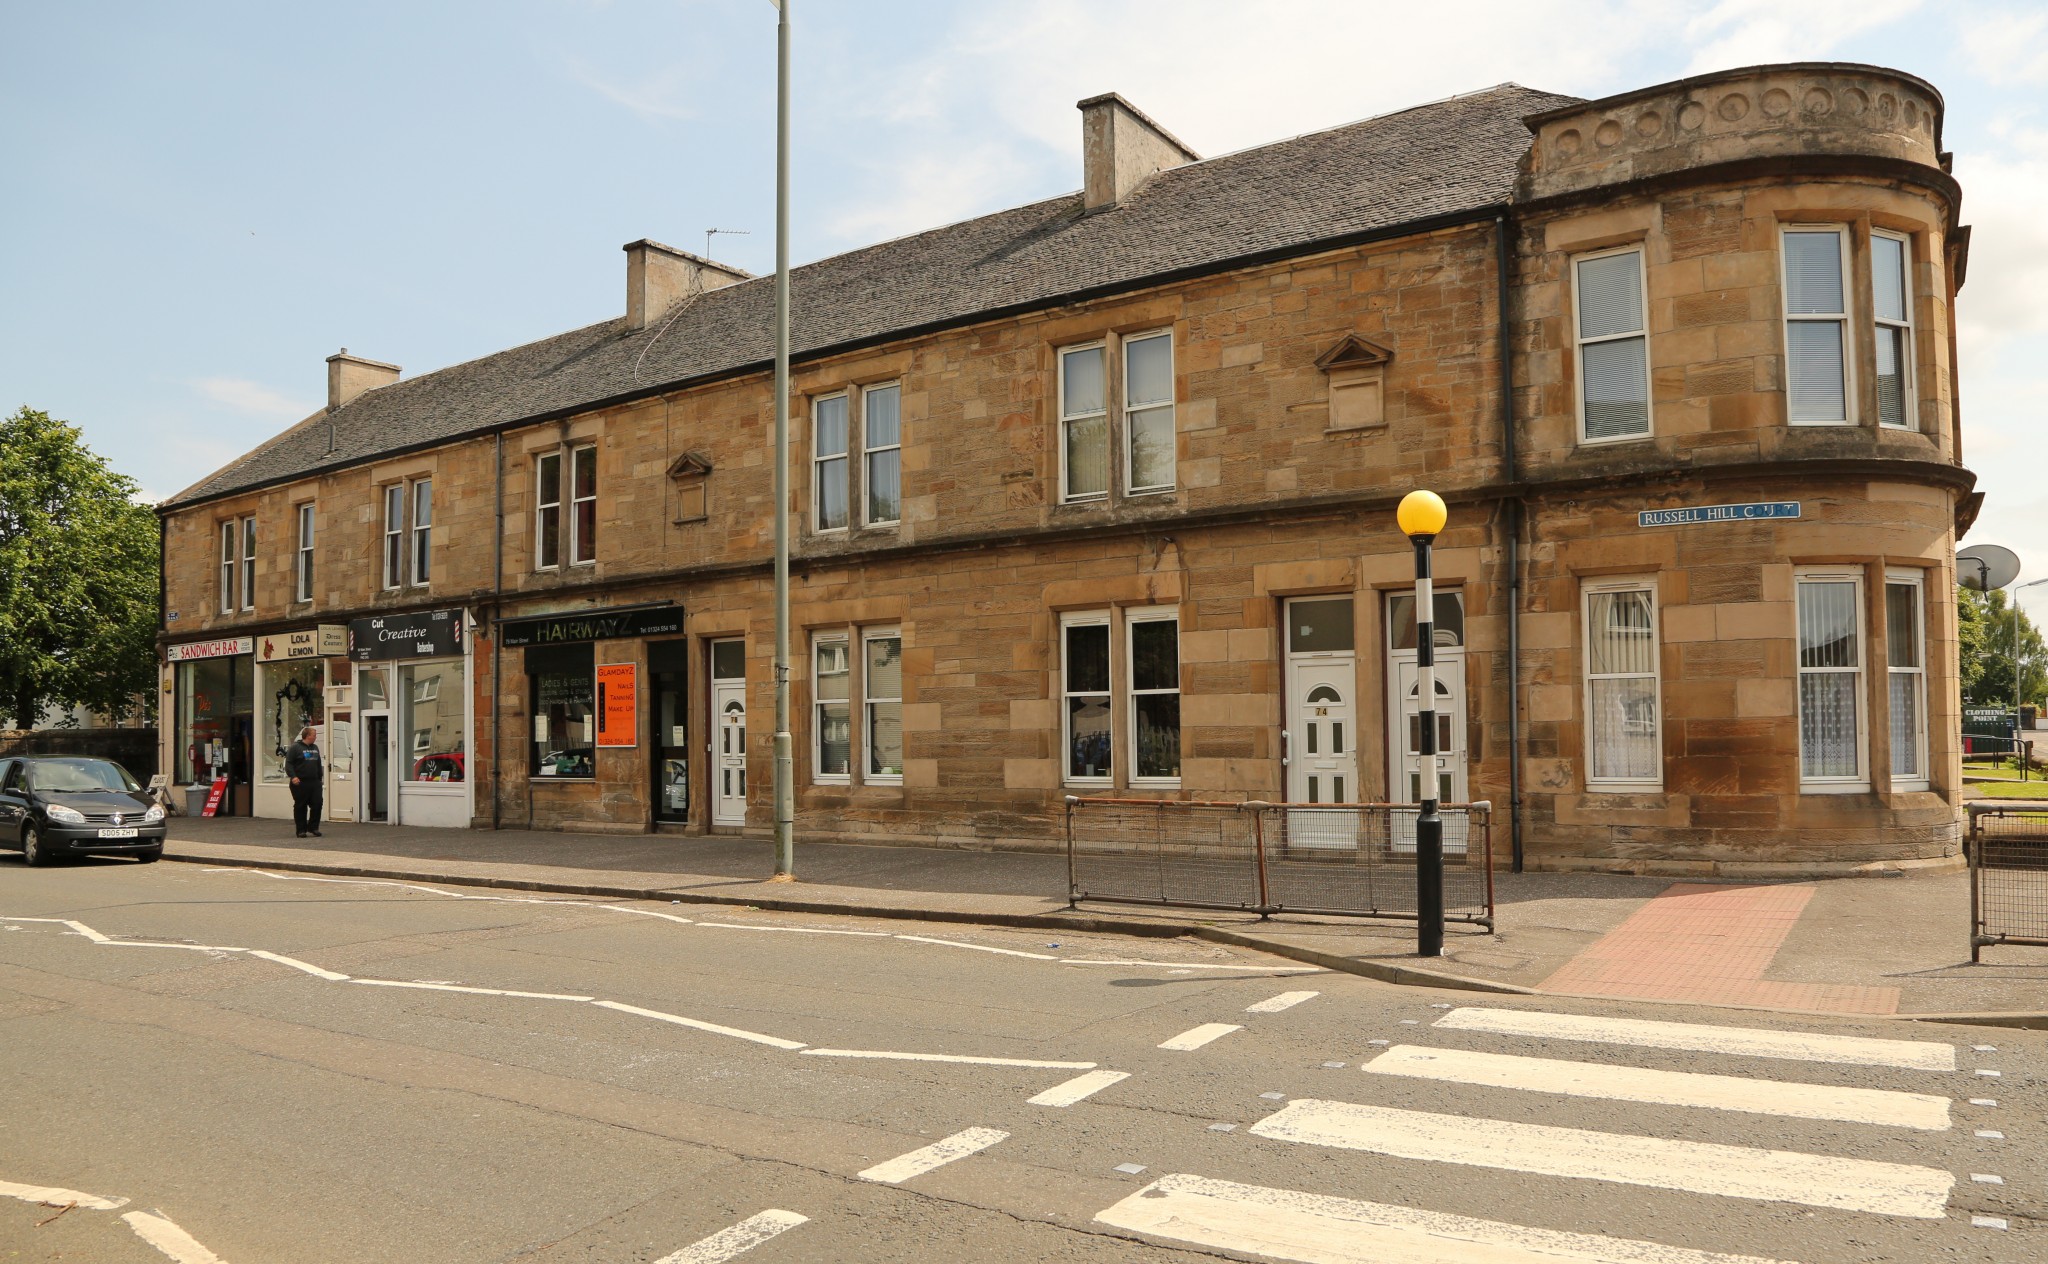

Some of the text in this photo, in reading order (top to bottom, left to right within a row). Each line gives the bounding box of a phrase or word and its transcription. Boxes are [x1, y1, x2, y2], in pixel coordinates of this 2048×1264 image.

[1645, 509, 1701, 524] RUSSELL
[1707, 508, 1737, 520] HILL
[371, 619, 384, 629] Cut
[536, 613, 632, 642] HAIRWAYZ
[291, 634, 310, 644] LOLA
[378, 626, 427, 642] Creative
[181, 641, 220, 659] SANDWICH
[223, 640, 239, 654] BAR
[288, 646, 313, 657] LEMON
[598, 666, 634, 677] GLAMDAYZ
[1316, 707, 1327, 716] 74
